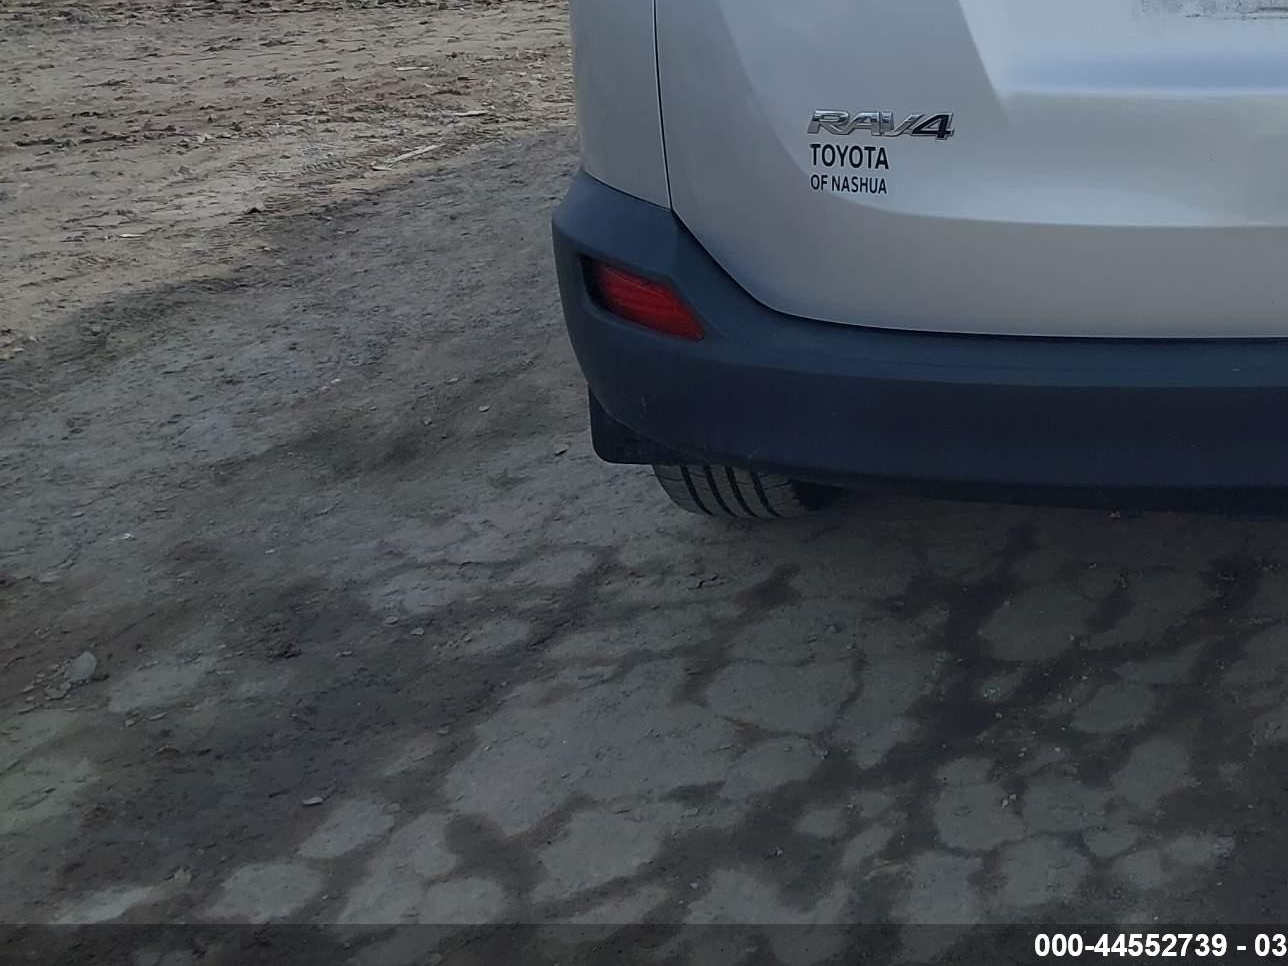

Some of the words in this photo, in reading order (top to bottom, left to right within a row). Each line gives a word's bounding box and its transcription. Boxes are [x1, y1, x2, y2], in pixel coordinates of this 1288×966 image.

[807, 109, 955, 140] RAV4
[810, 143, 889, 170] TOYOTA
[810, 174, 828, 190] OF
[832, 175, 888, 194] NASHUA
